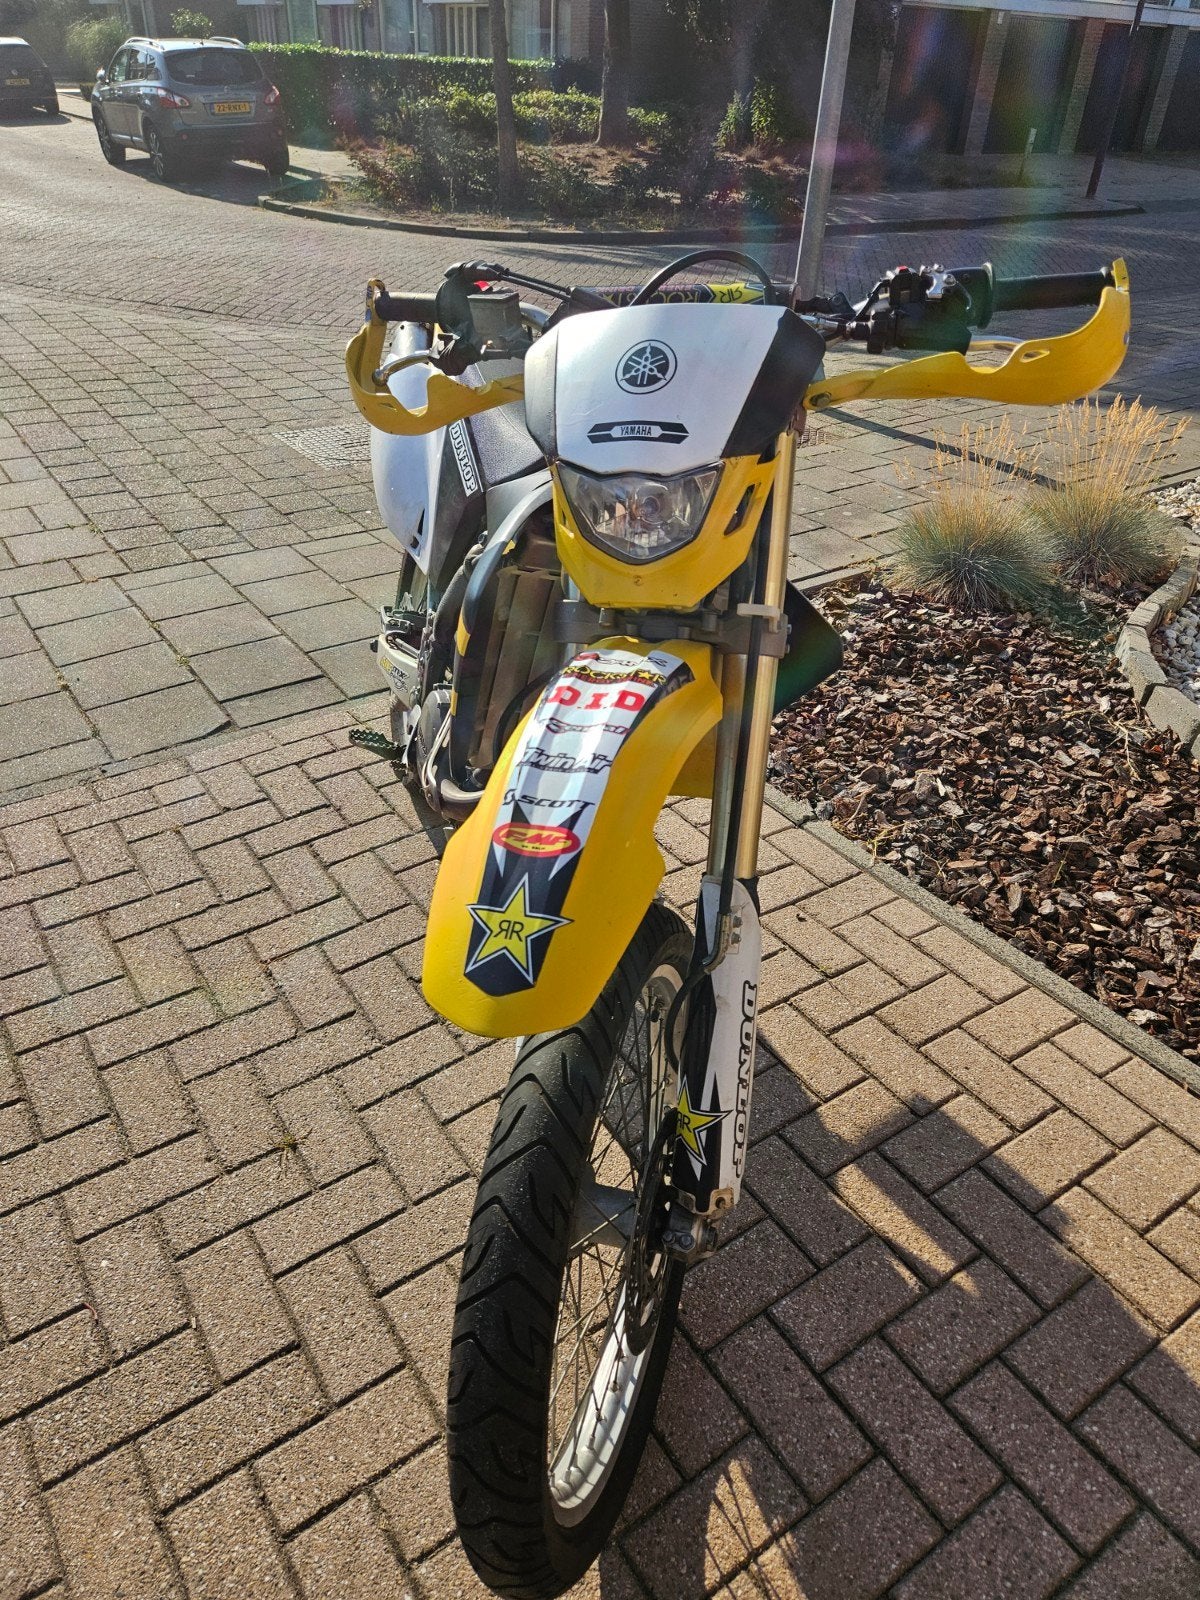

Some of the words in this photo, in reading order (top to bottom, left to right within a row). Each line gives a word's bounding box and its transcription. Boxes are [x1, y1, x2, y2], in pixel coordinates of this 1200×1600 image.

[620, 425, 653, 437] YAMAHA
[451, 424, 478, 492] DUNLOP
[518, 795, 595, 811] SCOTT
[732, 980, 758, 1178] DUNLOP
